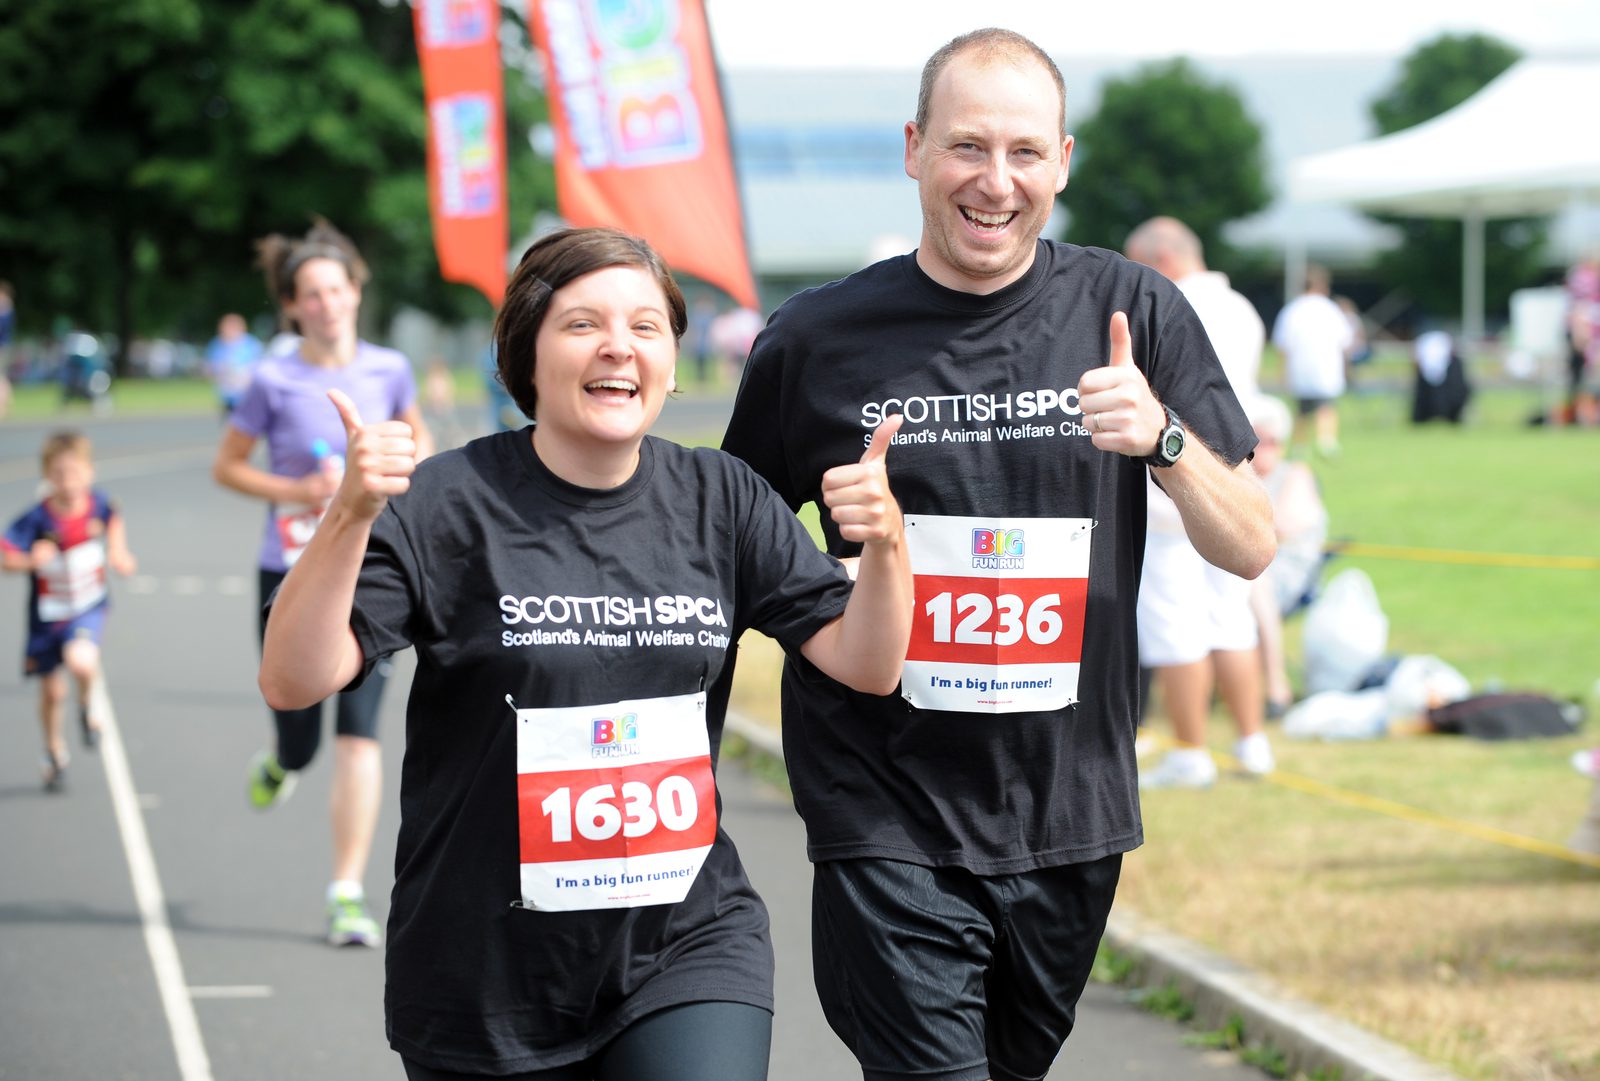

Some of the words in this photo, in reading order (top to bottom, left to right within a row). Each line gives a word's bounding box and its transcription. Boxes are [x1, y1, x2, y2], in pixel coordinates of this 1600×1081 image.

[861, 393, 1012, 428] SCOTTISH
[1016, 387, 1086, 418] SPC
[864, 427, 937, 448] Stland's
[941, 426, 991, 443] Animal
[996, 422, 1055, 441] Welfare
[972, 528, 1025, 557] BIG
[972, 557, 998, 569] FUN
[999, 558, 1024, 569] RUN
[499, 594, 652, 626] SCOTTISH
[654, 595, 728, 627] SPCA
[925, 591, 1063, 646] 1236
[501, 629, 580, 647] Scotland's
[584, 629, 631, 647] Animal
[636, 631, 695, 647] Welfare
[931, 676, 951, 688] I'm
[955, 680, 963, 688] a
[966, 677, 987, 692] big
[991, 679, 1008, 690] fun
[1011, 677, 1052, 689] runner!
[592, 713, 639, 746] BIG
[592, 746, 619, 758] FUN
[541, 775, 698, 843] 1630
[556, 877, 578, 888] I'm
[582, 878, 590, 887] a
[594, 874, 616, 888] big
[621, 873, 643, 884] fun
[647, 865, 694, 881] runner!
